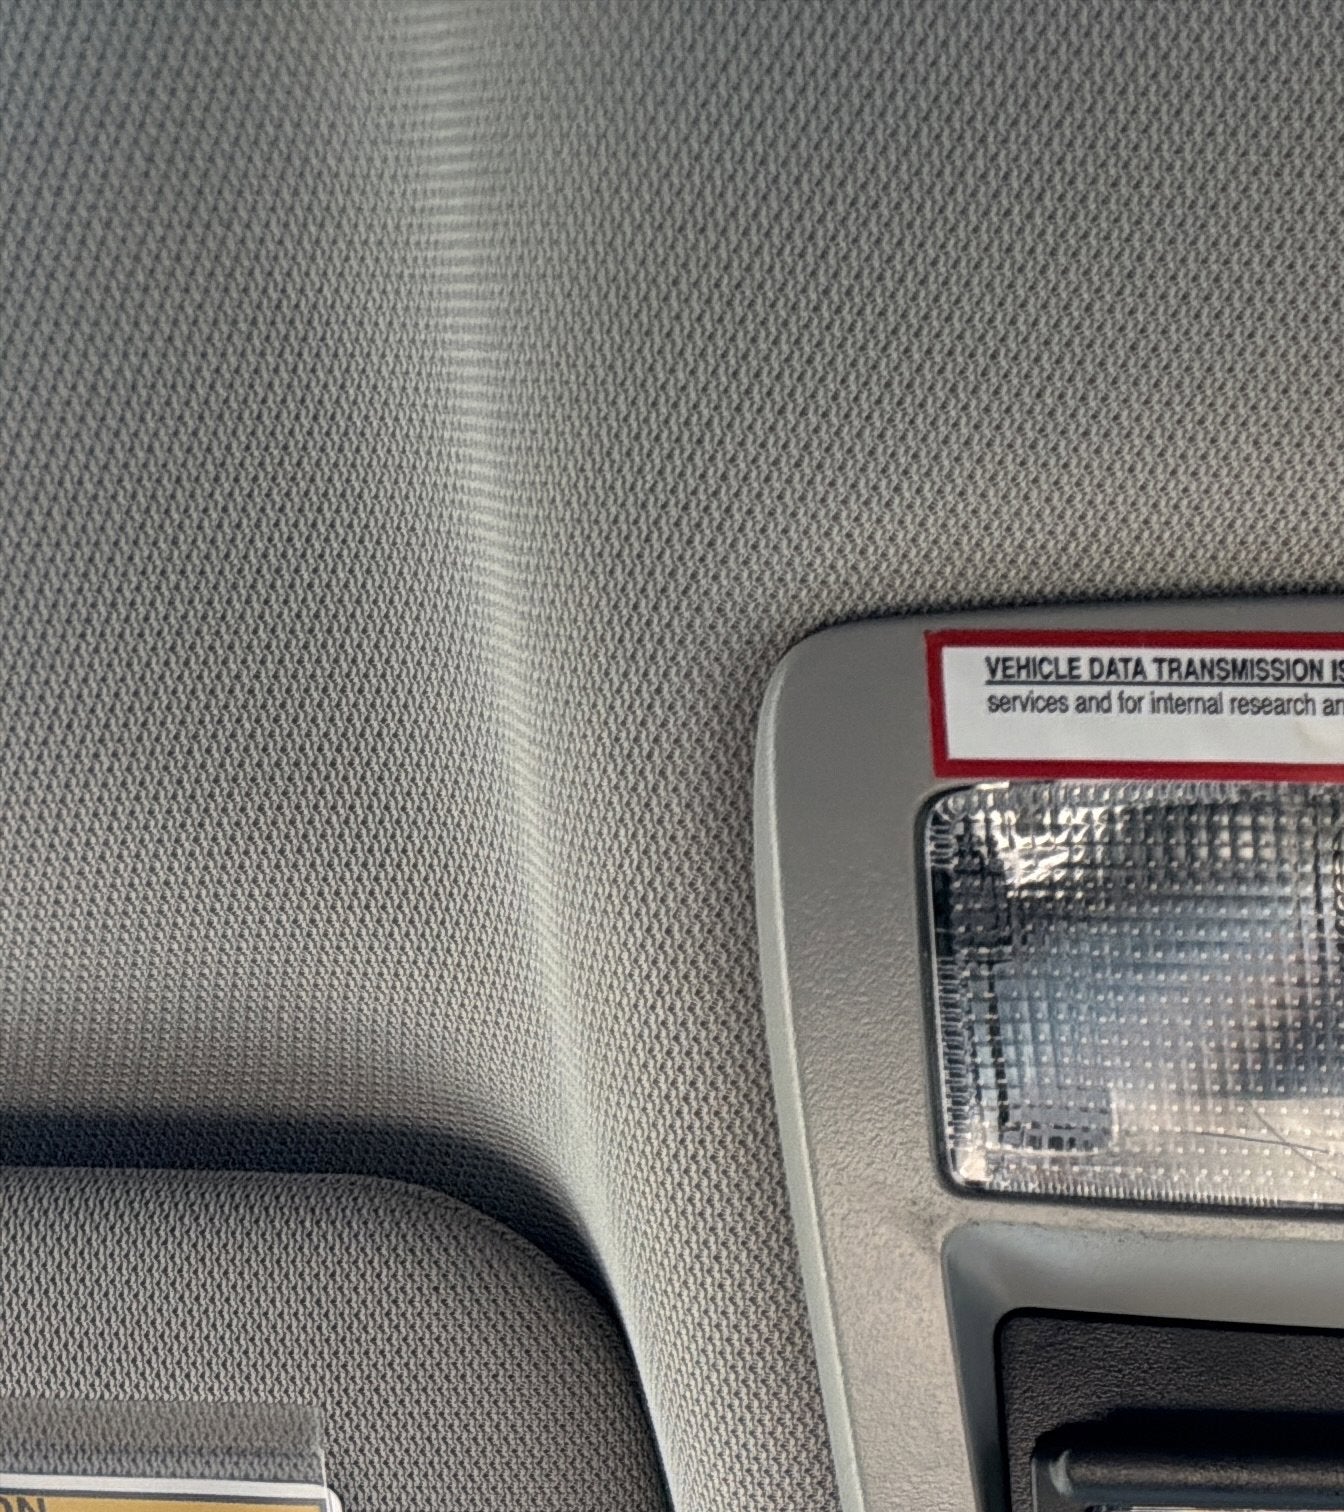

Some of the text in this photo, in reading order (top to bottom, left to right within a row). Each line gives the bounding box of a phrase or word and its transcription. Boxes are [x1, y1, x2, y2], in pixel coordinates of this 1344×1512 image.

[986, 656, 1082, 681] VEHICLE
[1090, 658, 1146, 681] DATA
[1152, 658, 1325, 683] TRANSMISSION
[987, 693, 1069, 714] services
[1074, 693, 1111, 714] and
[1117, 693, 1143, 714] for
[1150, 692, 1224, 715] internal
[1230, 694, 1316, 716] research
